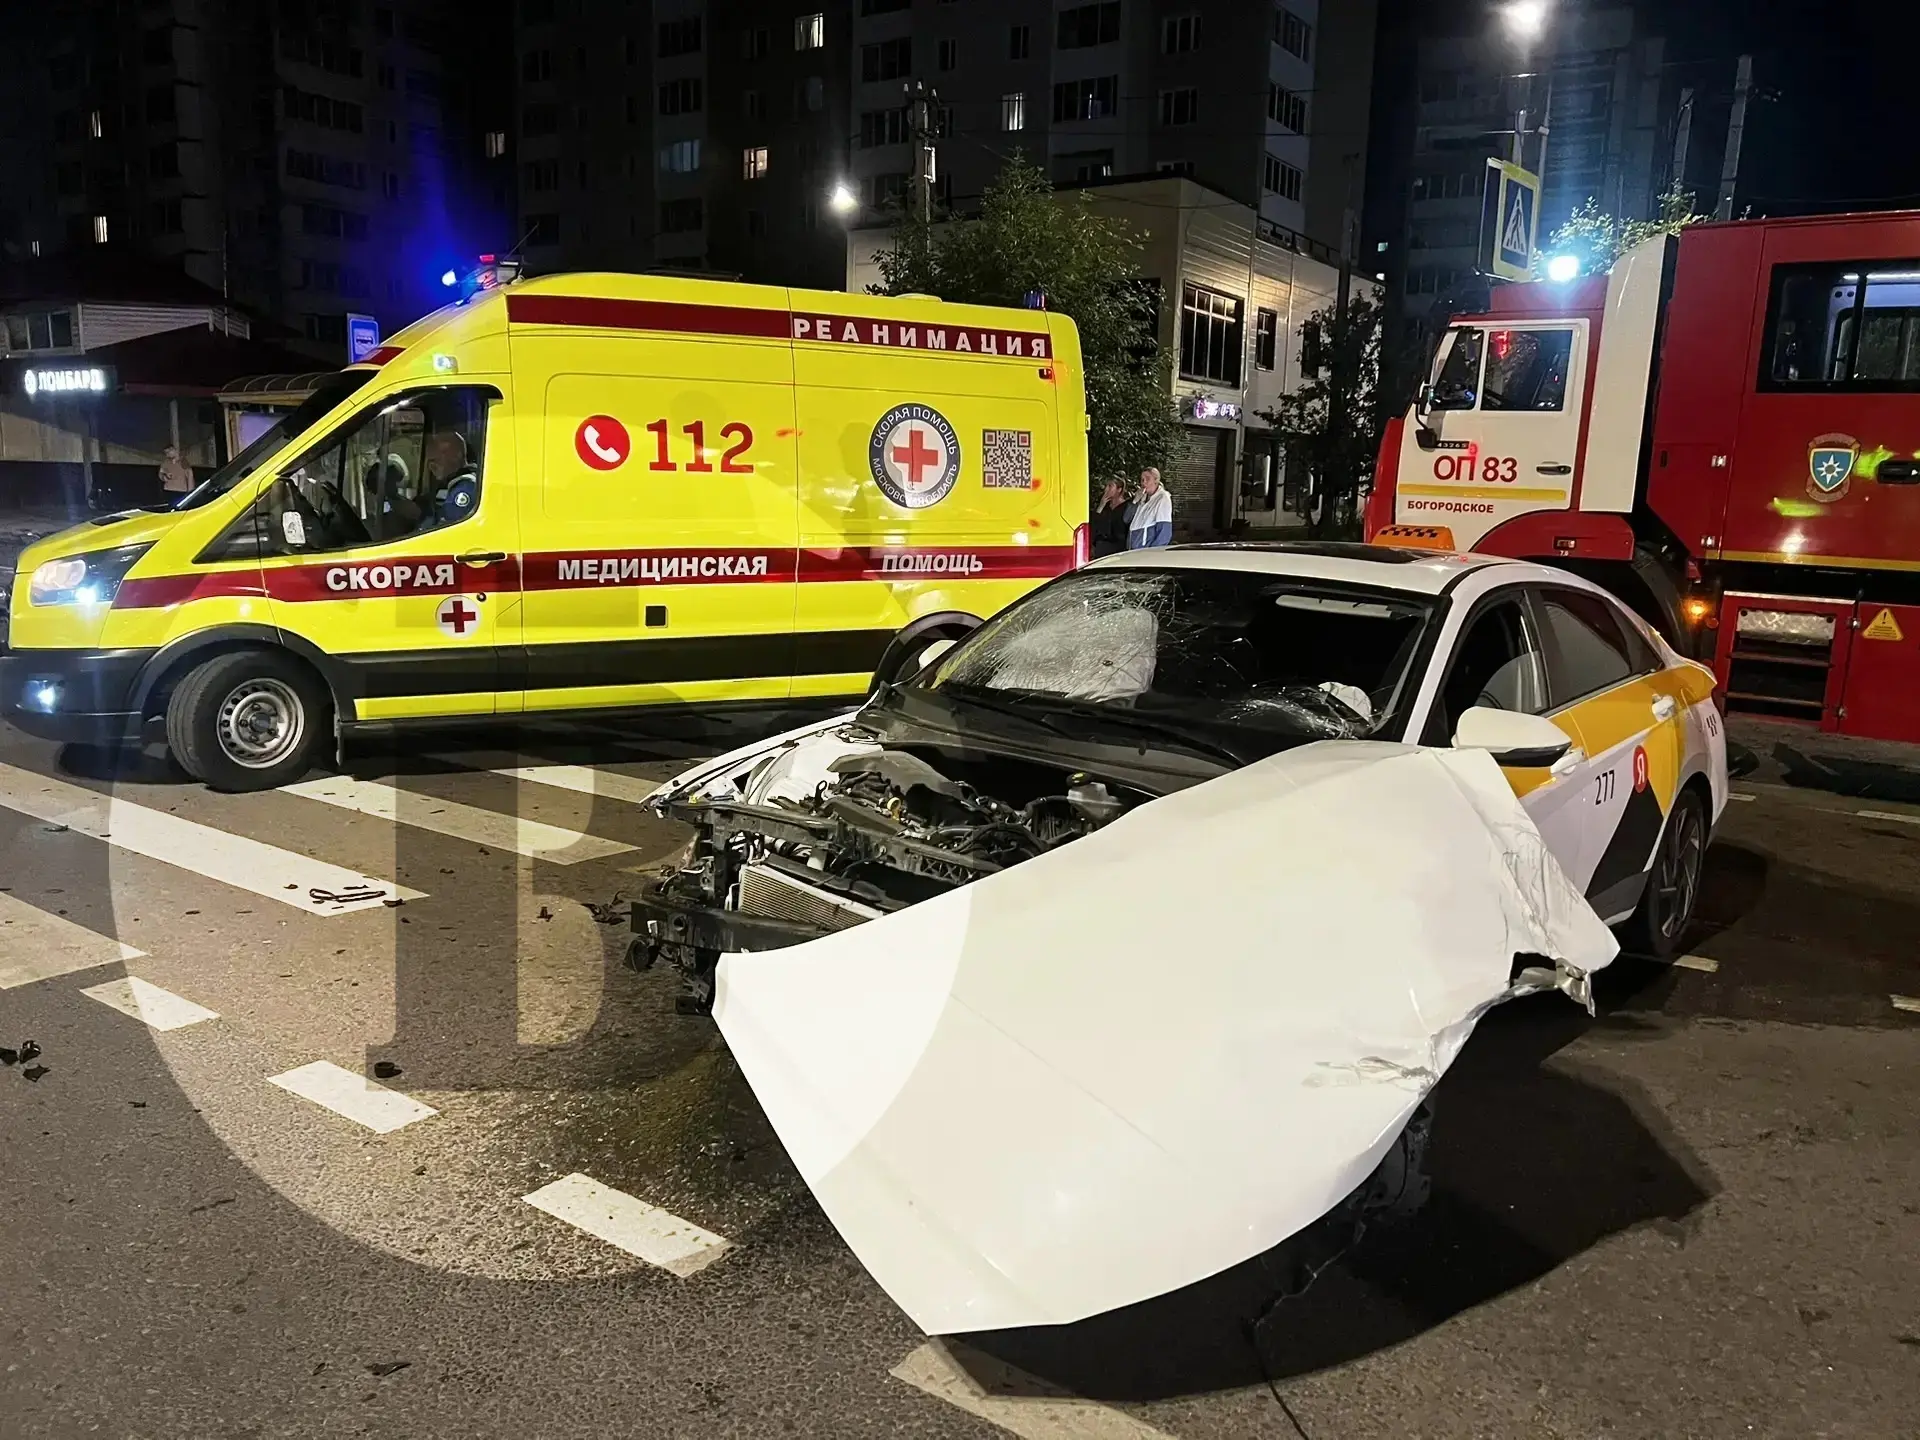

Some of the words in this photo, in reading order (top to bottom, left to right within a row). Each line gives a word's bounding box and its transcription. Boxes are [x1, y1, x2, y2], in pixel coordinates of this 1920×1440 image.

[793, 318, 1047, 357] РЕАНИМАЦИЯ
[38, 368, 106, 391] ЛОМБАРД
[646, 418, 754, 473] 112
[873, 407, 910, 448] СКОРАЯ
[913, 406, 957, 455] ПОМОЩЬ
[1433, 455, 1476, 481] ОП
[1482, 457, 1518, 482] 83
[1407, 500, 1495, 513] БОГОРОДСКОЕ
[326, 564, 455, 591] СКОРАЯ
[558, 556, 768, 583] МЕДИЦИНСКАЯ
[882, 554, 983, 576] ПОМОЩЬ
[1595, 769, 1615, 806] 277
